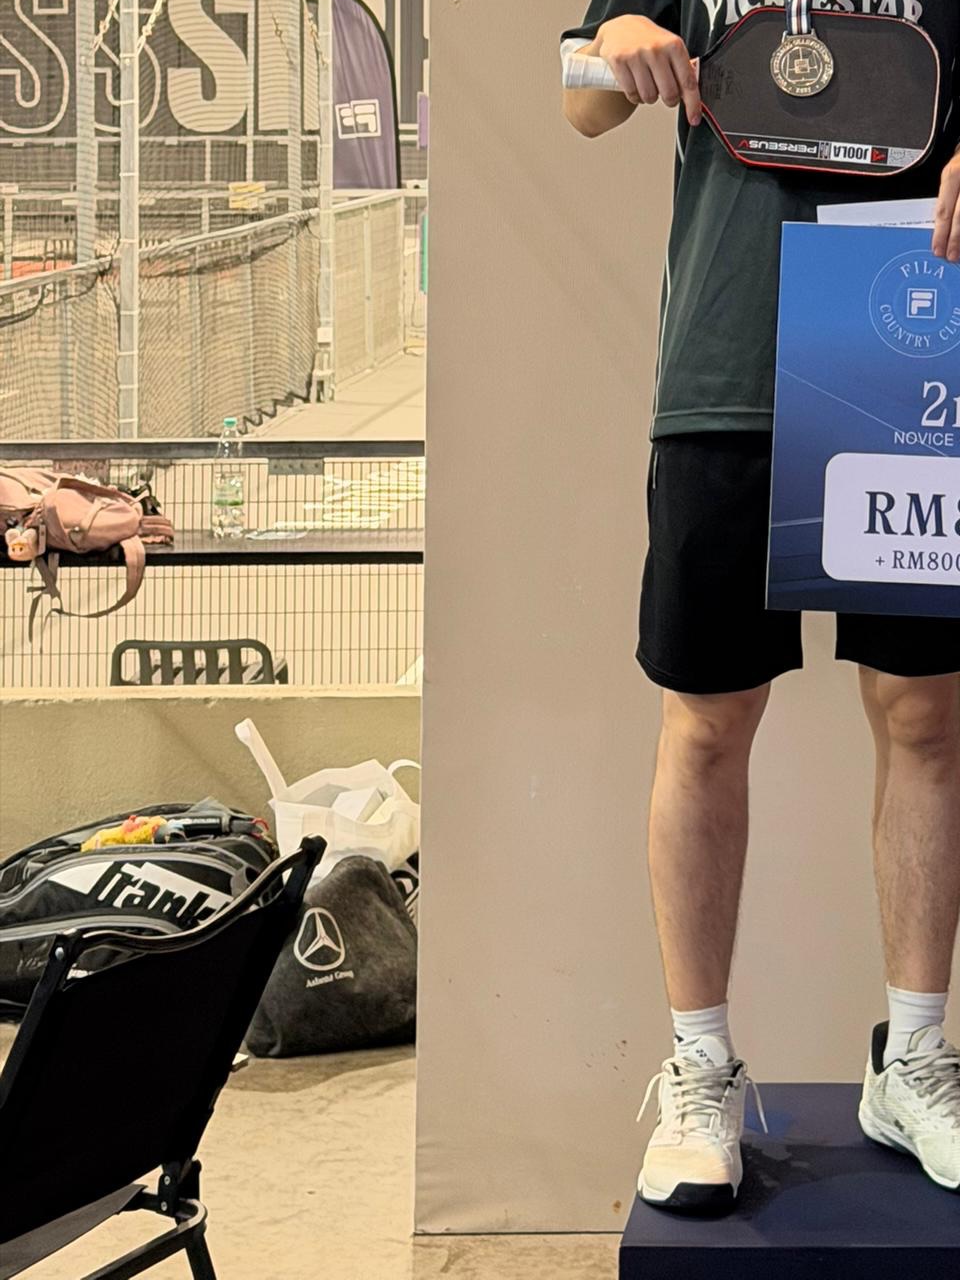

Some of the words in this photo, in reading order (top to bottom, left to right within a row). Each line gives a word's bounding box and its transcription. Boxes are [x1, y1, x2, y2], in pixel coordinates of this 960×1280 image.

[833, 145, 870, 160] JOOLA
[900, 260, 945, 280] FILA
[880, 304, 931, 348] COUNTRY
[893, 430, 954, 447] NOVICE
